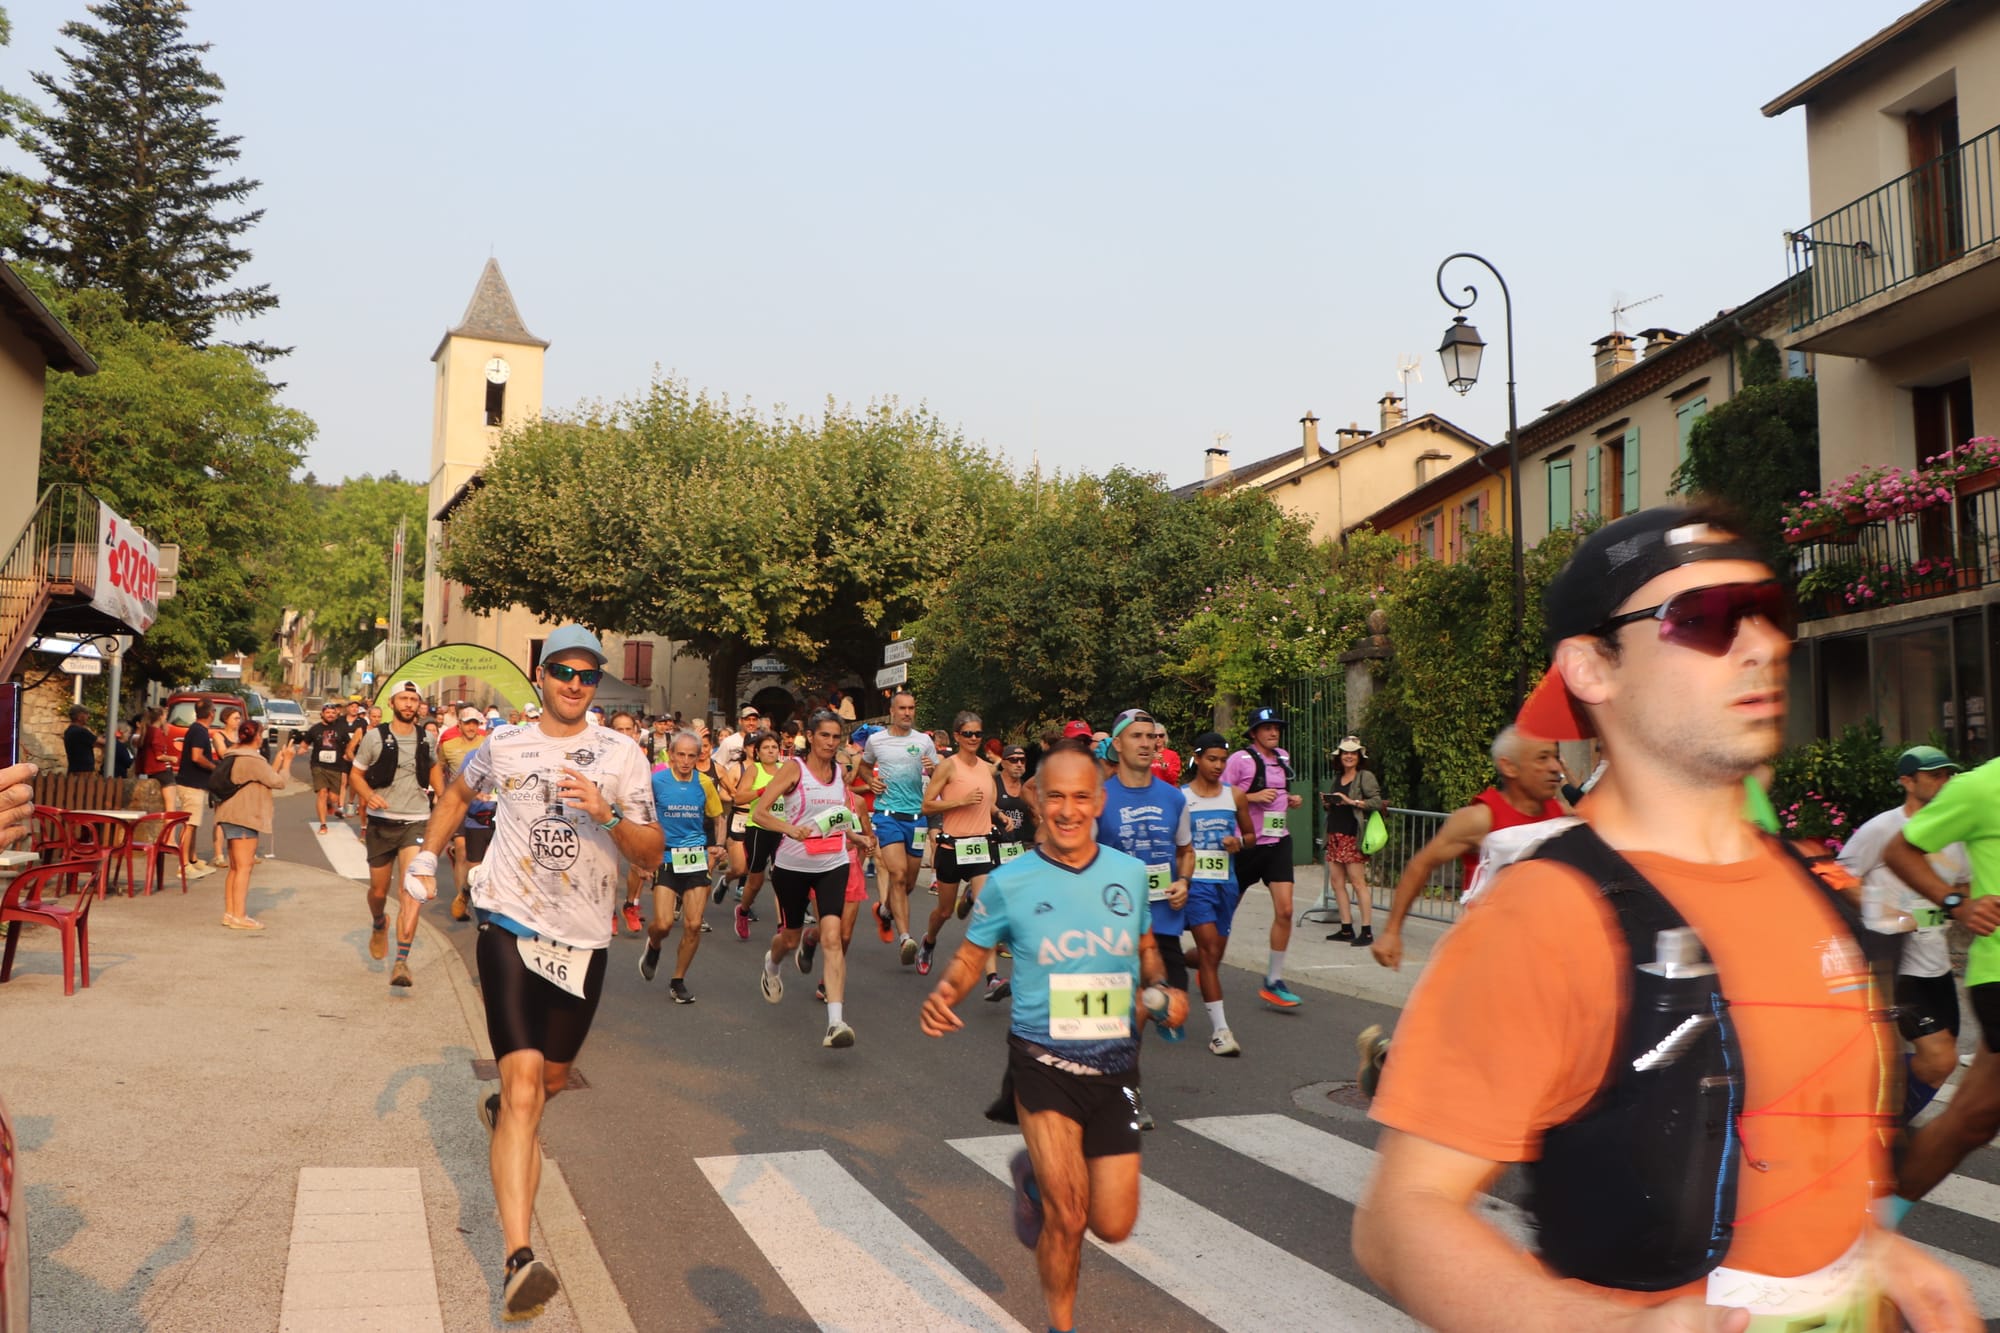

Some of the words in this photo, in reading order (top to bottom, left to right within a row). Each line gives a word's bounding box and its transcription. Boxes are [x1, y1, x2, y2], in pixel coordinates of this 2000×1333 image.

[829, 812, 844, 827] 68
[533, 829, 574, 843] STAR
[534, 843, 576, 859] TROC
[966, 844, 981, 855] 56
[1007, 847, 1018, 857] 59
[681, 853, 697, 864] 10
[1197, 858, 1224, 870] 135
[1037, 926, 1134, 965] ACNA
[534, 957, 568, 981] 146
[1074, 991, 1109, 1016] 11
